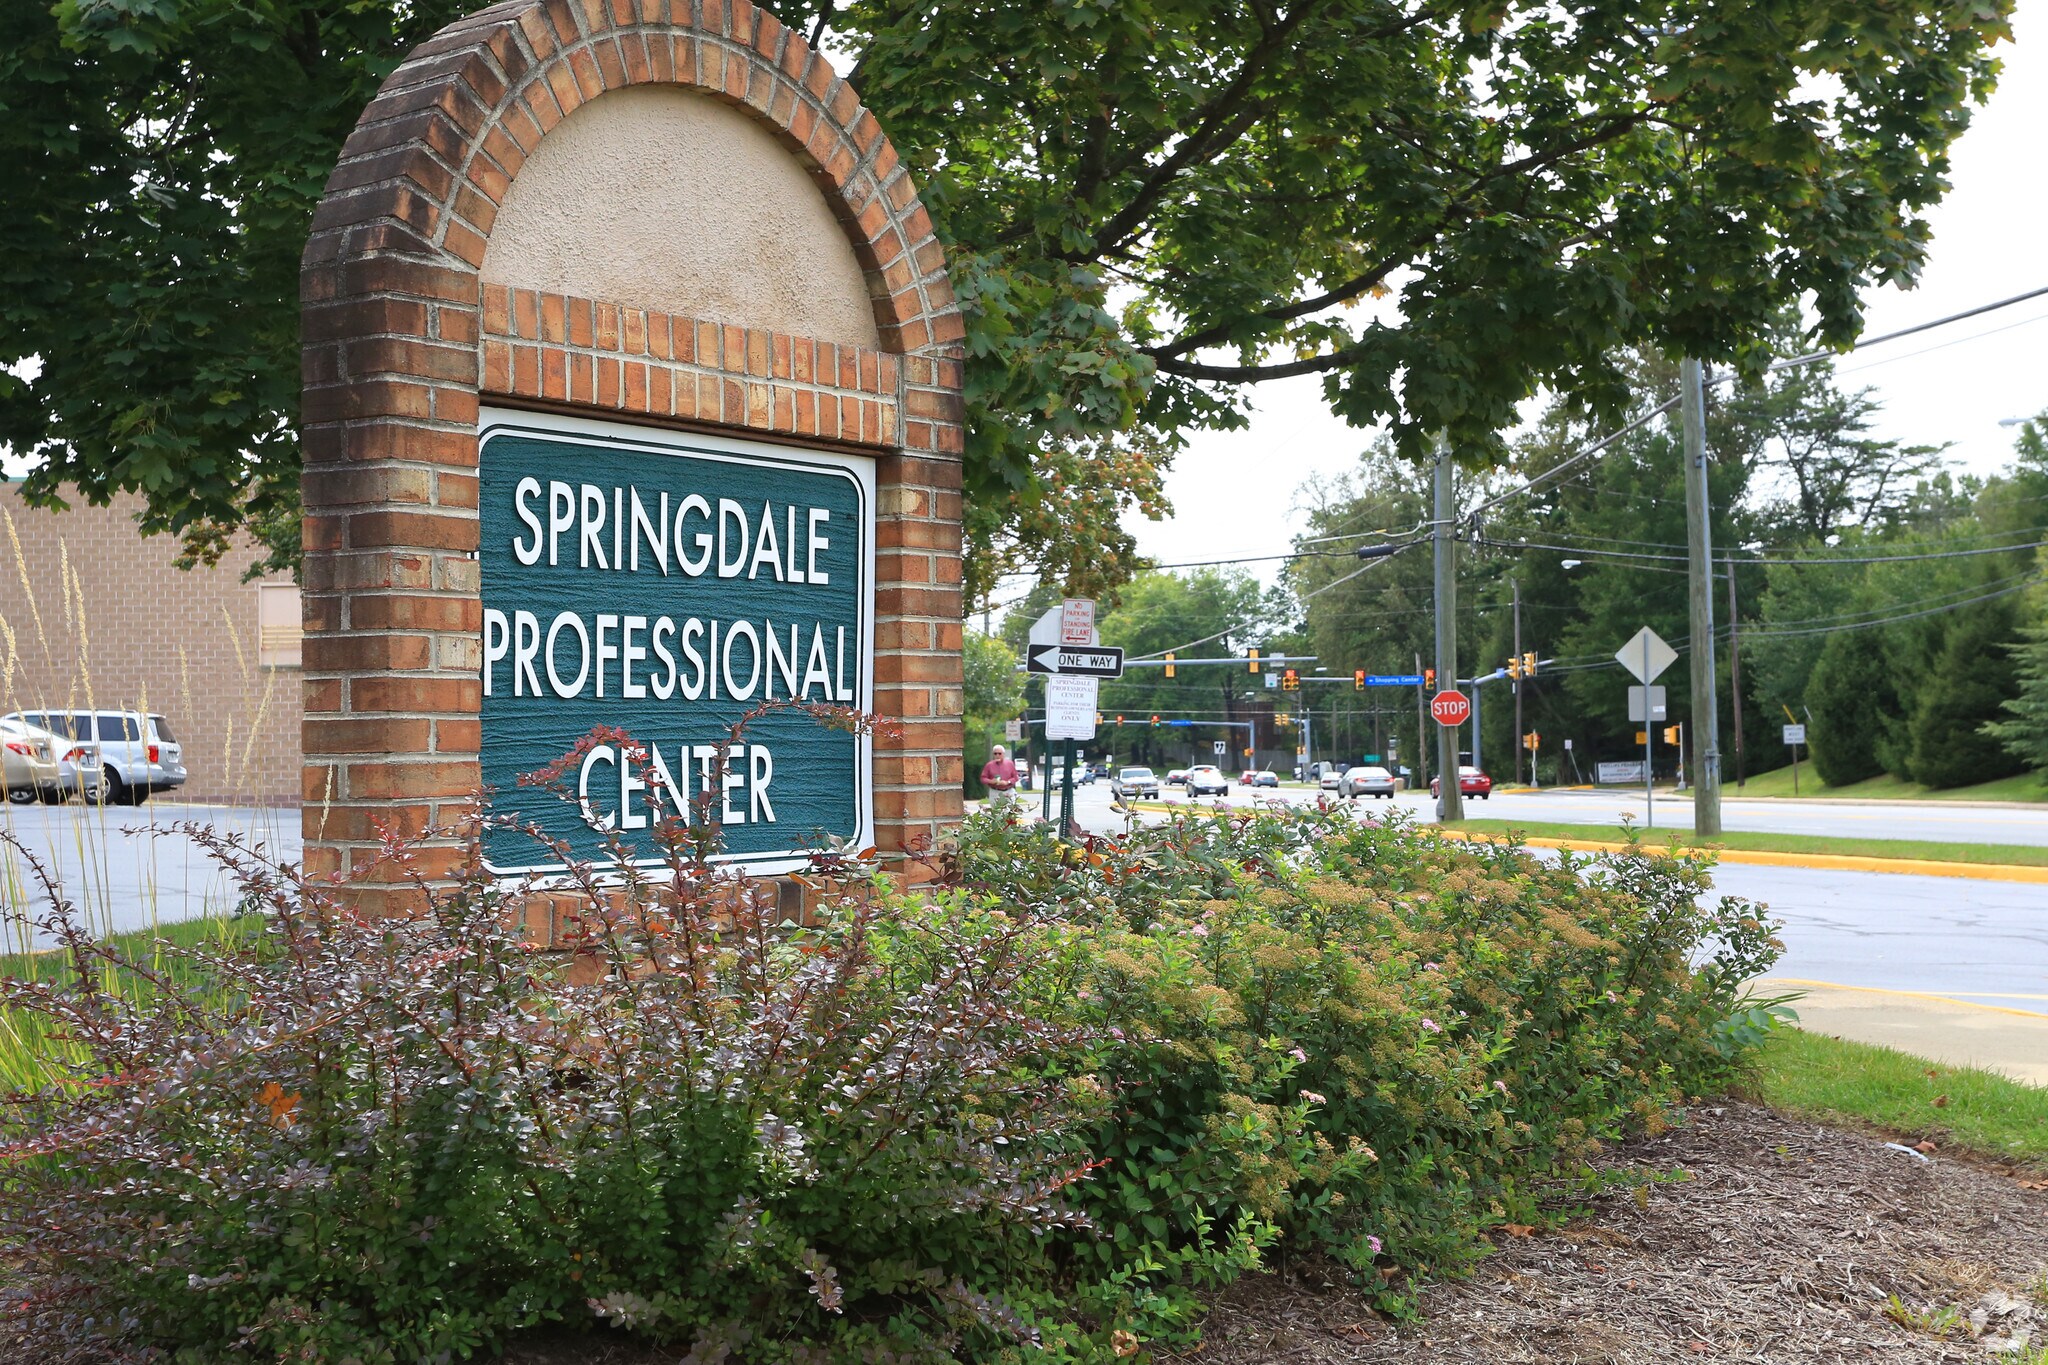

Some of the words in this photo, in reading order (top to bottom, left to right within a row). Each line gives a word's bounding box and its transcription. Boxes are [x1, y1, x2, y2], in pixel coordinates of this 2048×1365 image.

[513, 476, 830, 584] SPRINGDALE
[483, 608, 853, 701] PROFESSIONAL
[1059, 654, 1082, 666] ONE
[1090, 656, 1113, 667] WAY
[1434, 701, 1467, 715] STOP
[579, 742, 777, 831] CENTER
